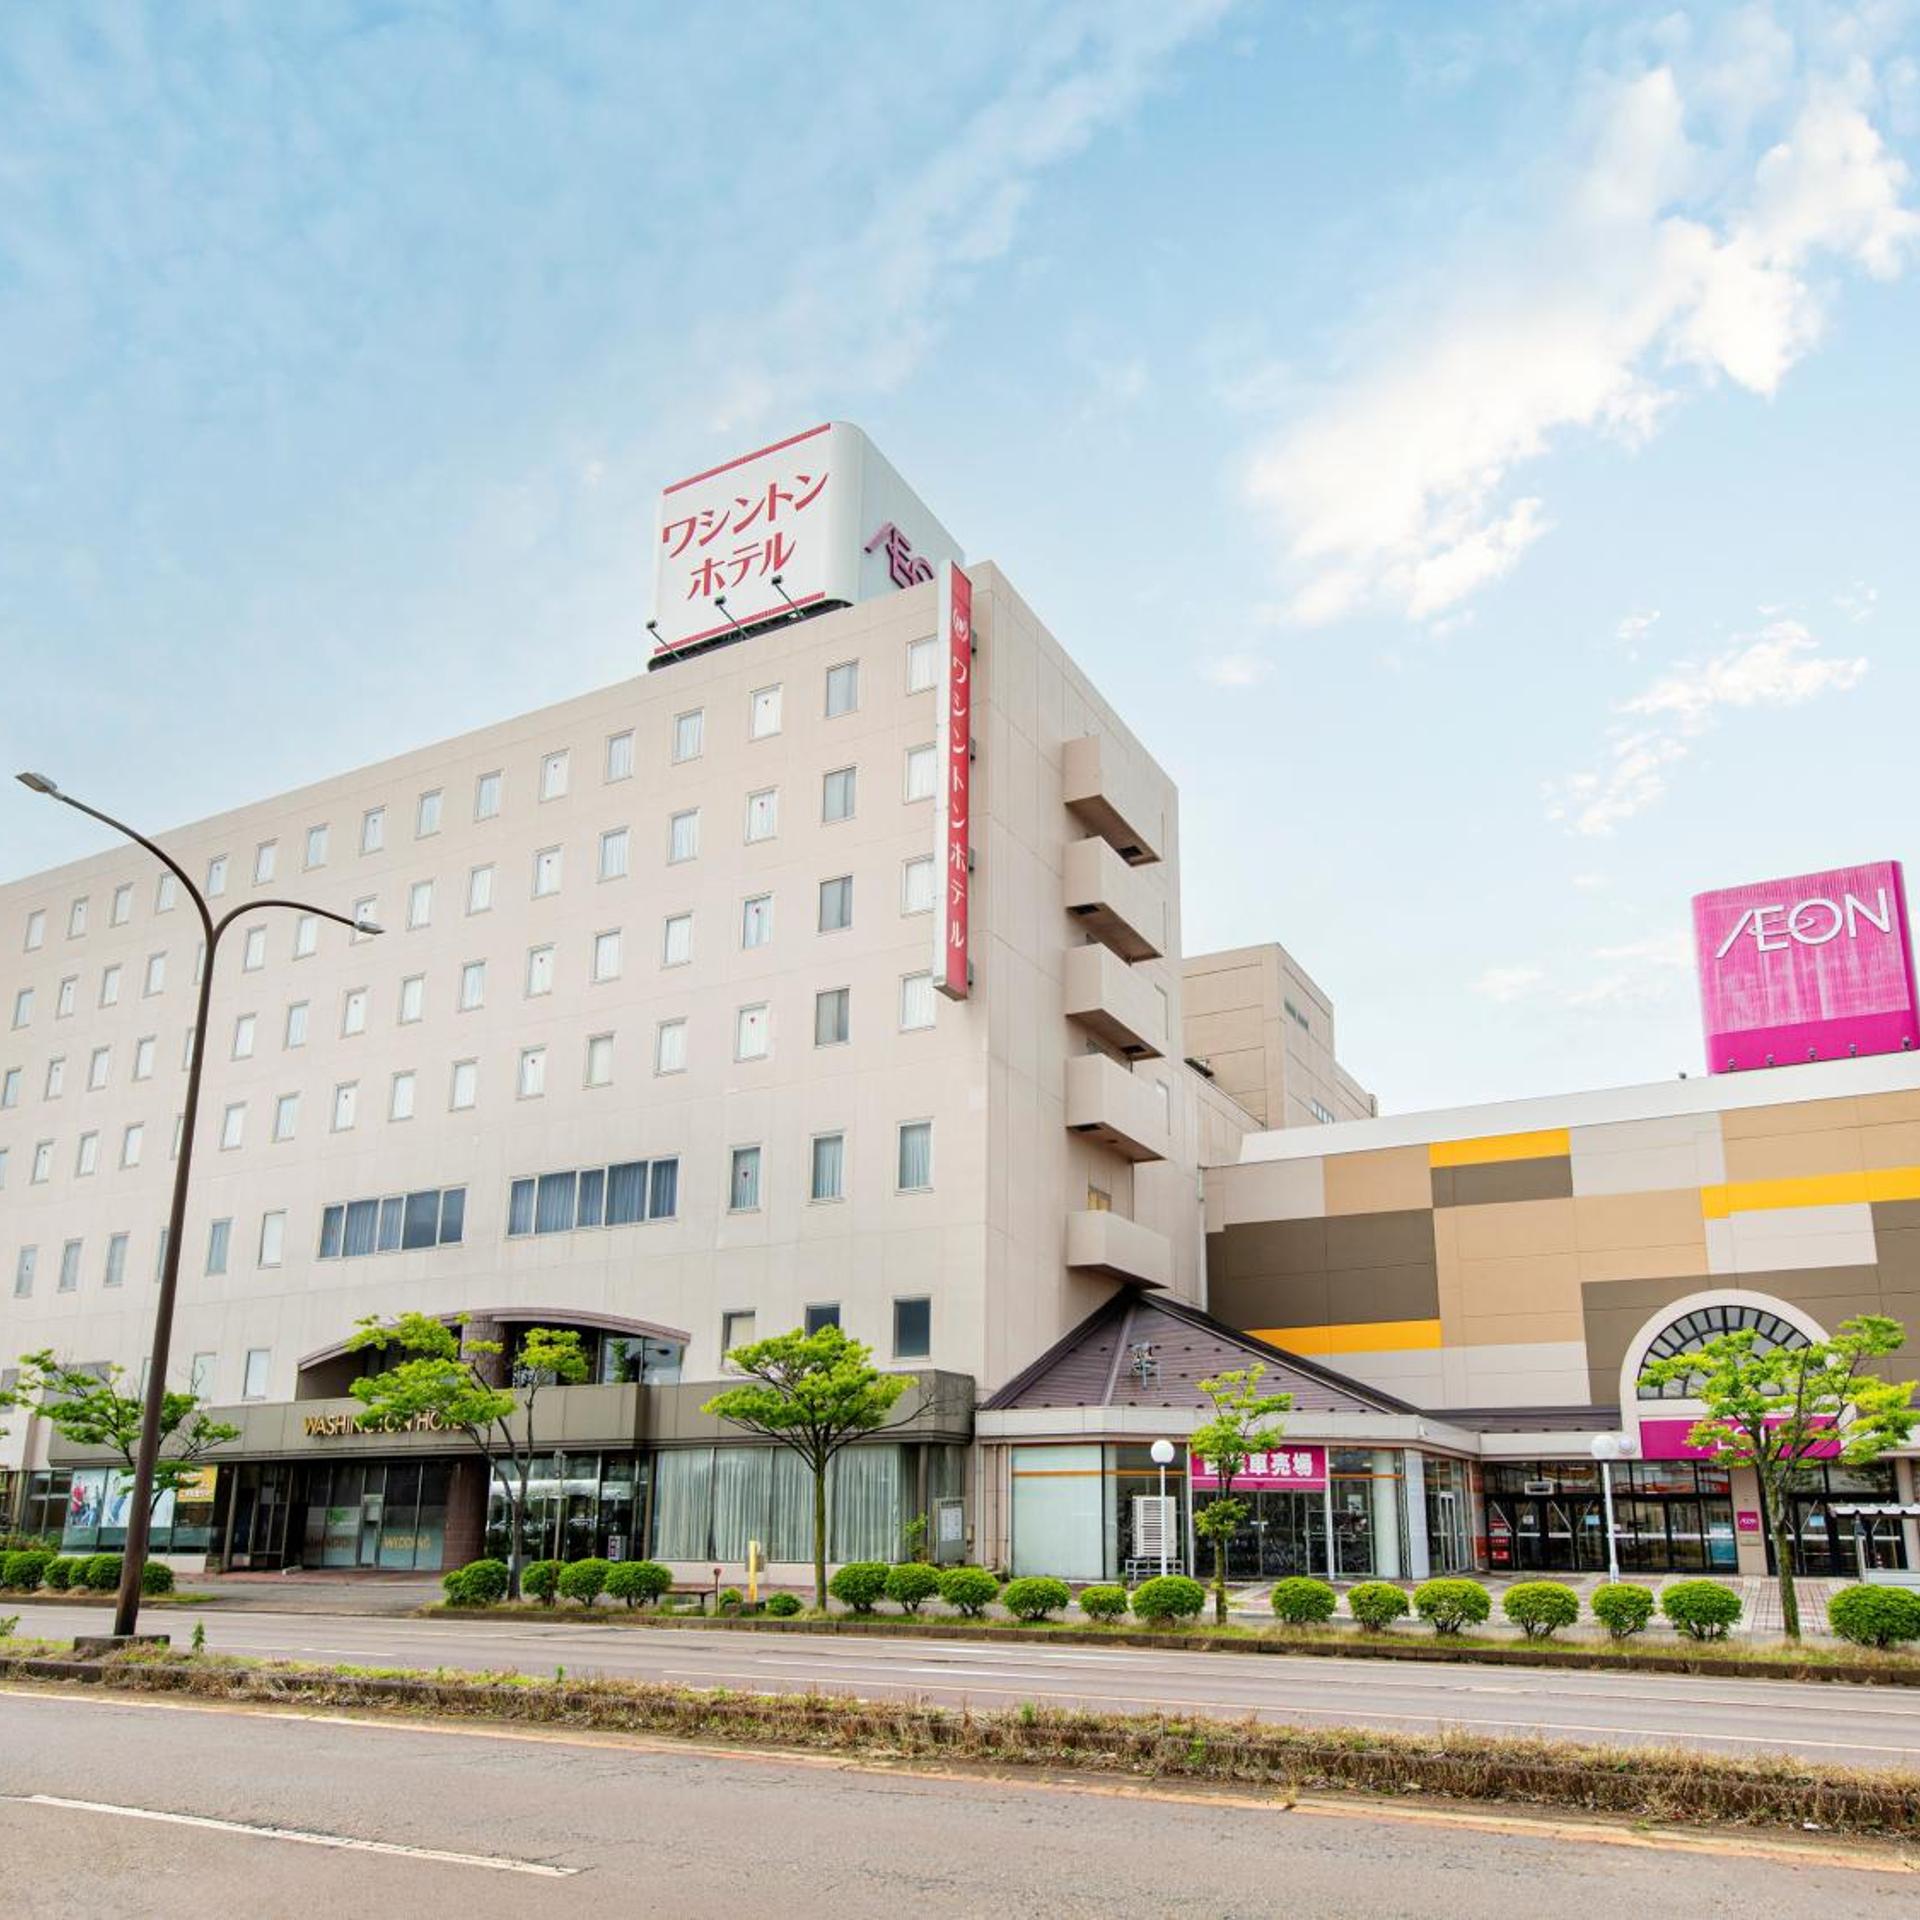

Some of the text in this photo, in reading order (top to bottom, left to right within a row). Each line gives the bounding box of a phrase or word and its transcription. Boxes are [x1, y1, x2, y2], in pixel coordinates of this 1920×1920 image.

[662, 472, 829, 559] ワシントン
[687, 532, 796, 601] ホテル
[950, 655, 968, 948] ワシントンホテル
